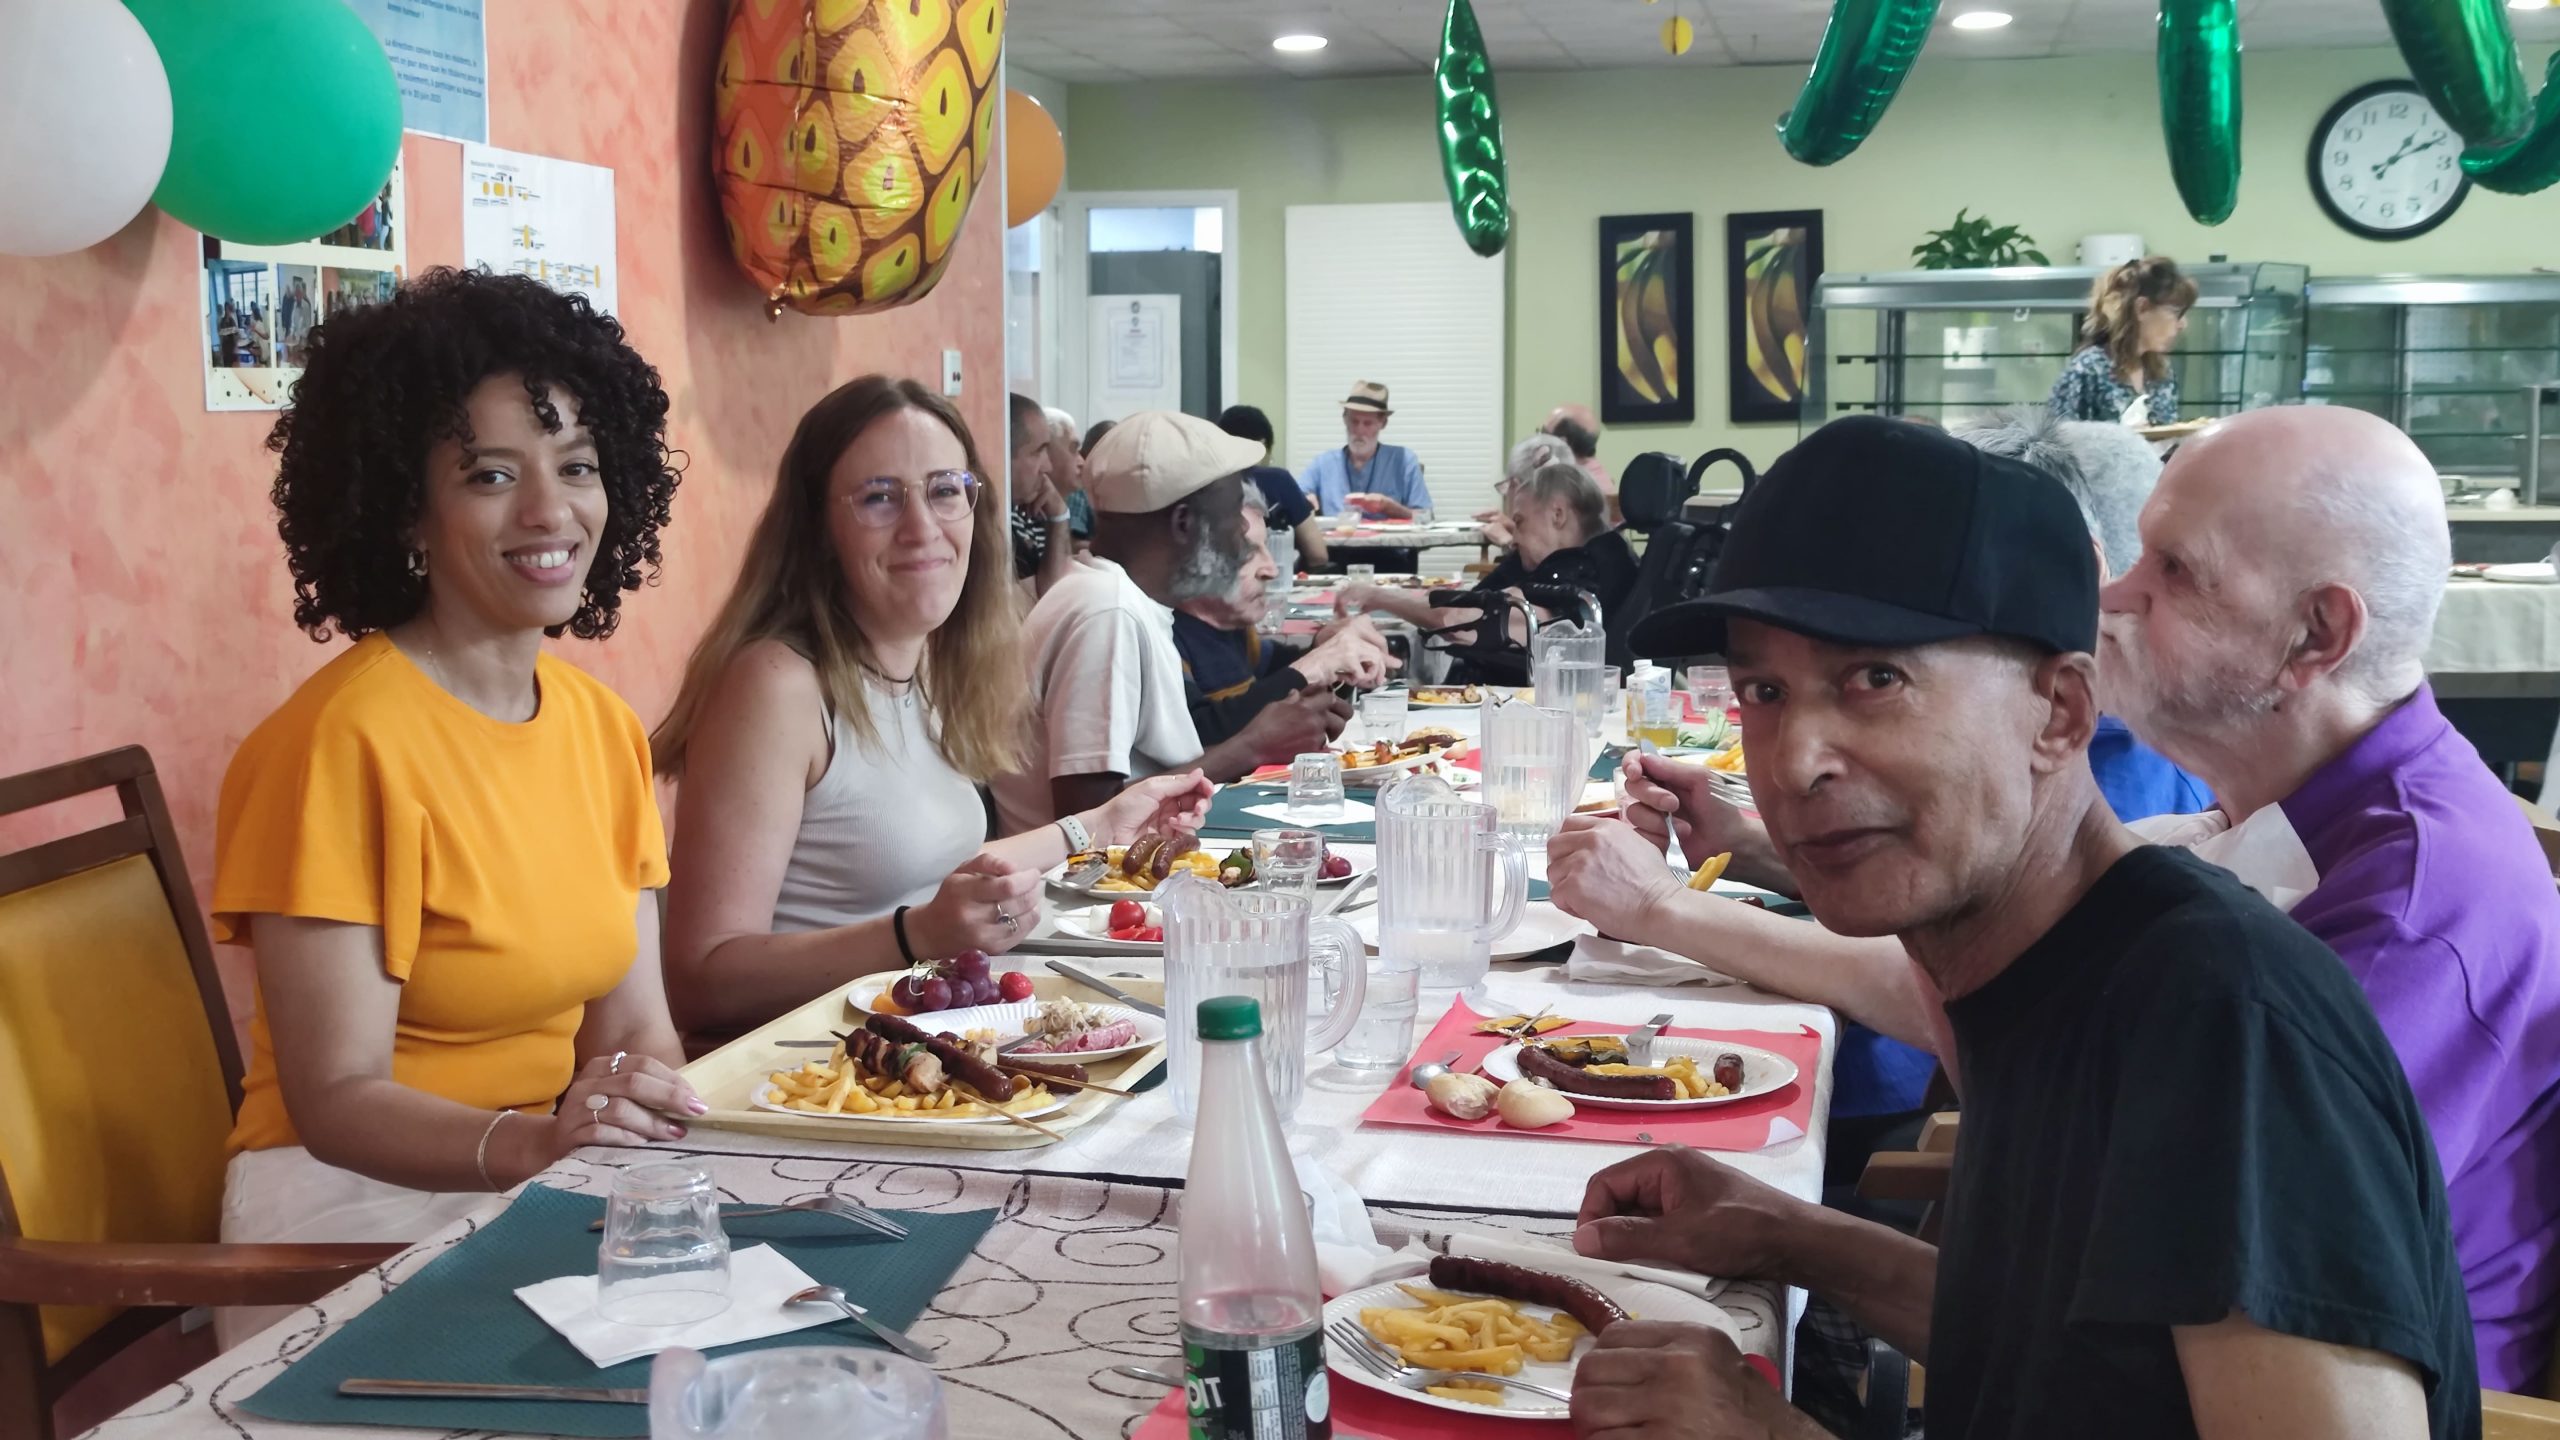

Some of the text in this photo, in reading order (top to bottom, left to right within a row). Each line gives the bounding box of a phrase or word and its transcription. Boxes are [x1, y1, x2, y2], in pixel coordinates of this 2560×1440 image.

[2362, 110, 2377, 126] 11
[2388, 103, 2409, 119] 12
[2343, 127, 2362, 143] 10
[2432, 129, 2448, 146] 2
[2334, 151, 2349, 167] 9
[2437, 155, 2452, 170] 3
[2340, 174, 2353, 191] 8
[2425, 178, 2439, 194] 4
[2355, 194, 2369, 210] 7
[2380, 202, 2394, 218] 6
[2406, 197, 2421, 213] 5
